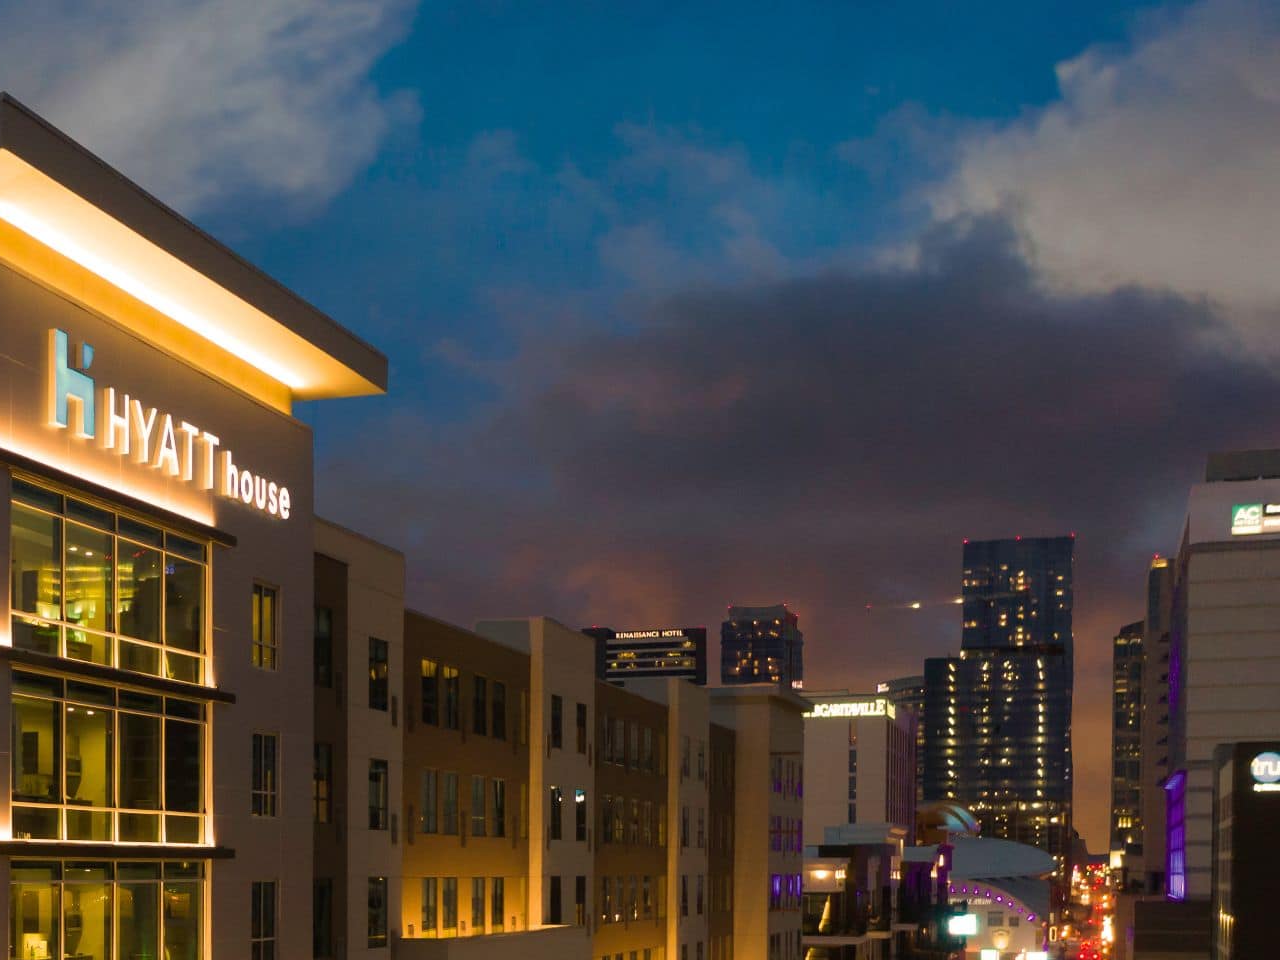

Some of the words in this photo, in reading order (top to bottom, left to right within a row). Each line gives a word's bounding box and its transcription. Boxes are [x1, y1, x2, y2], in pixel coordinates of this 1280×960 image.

[104, 386, 219, 490] HYATT
[224, 450, 291, 520] house
[1234, 506, 1260, 521] AC
[662, 630, 683, 638] HOTEL
